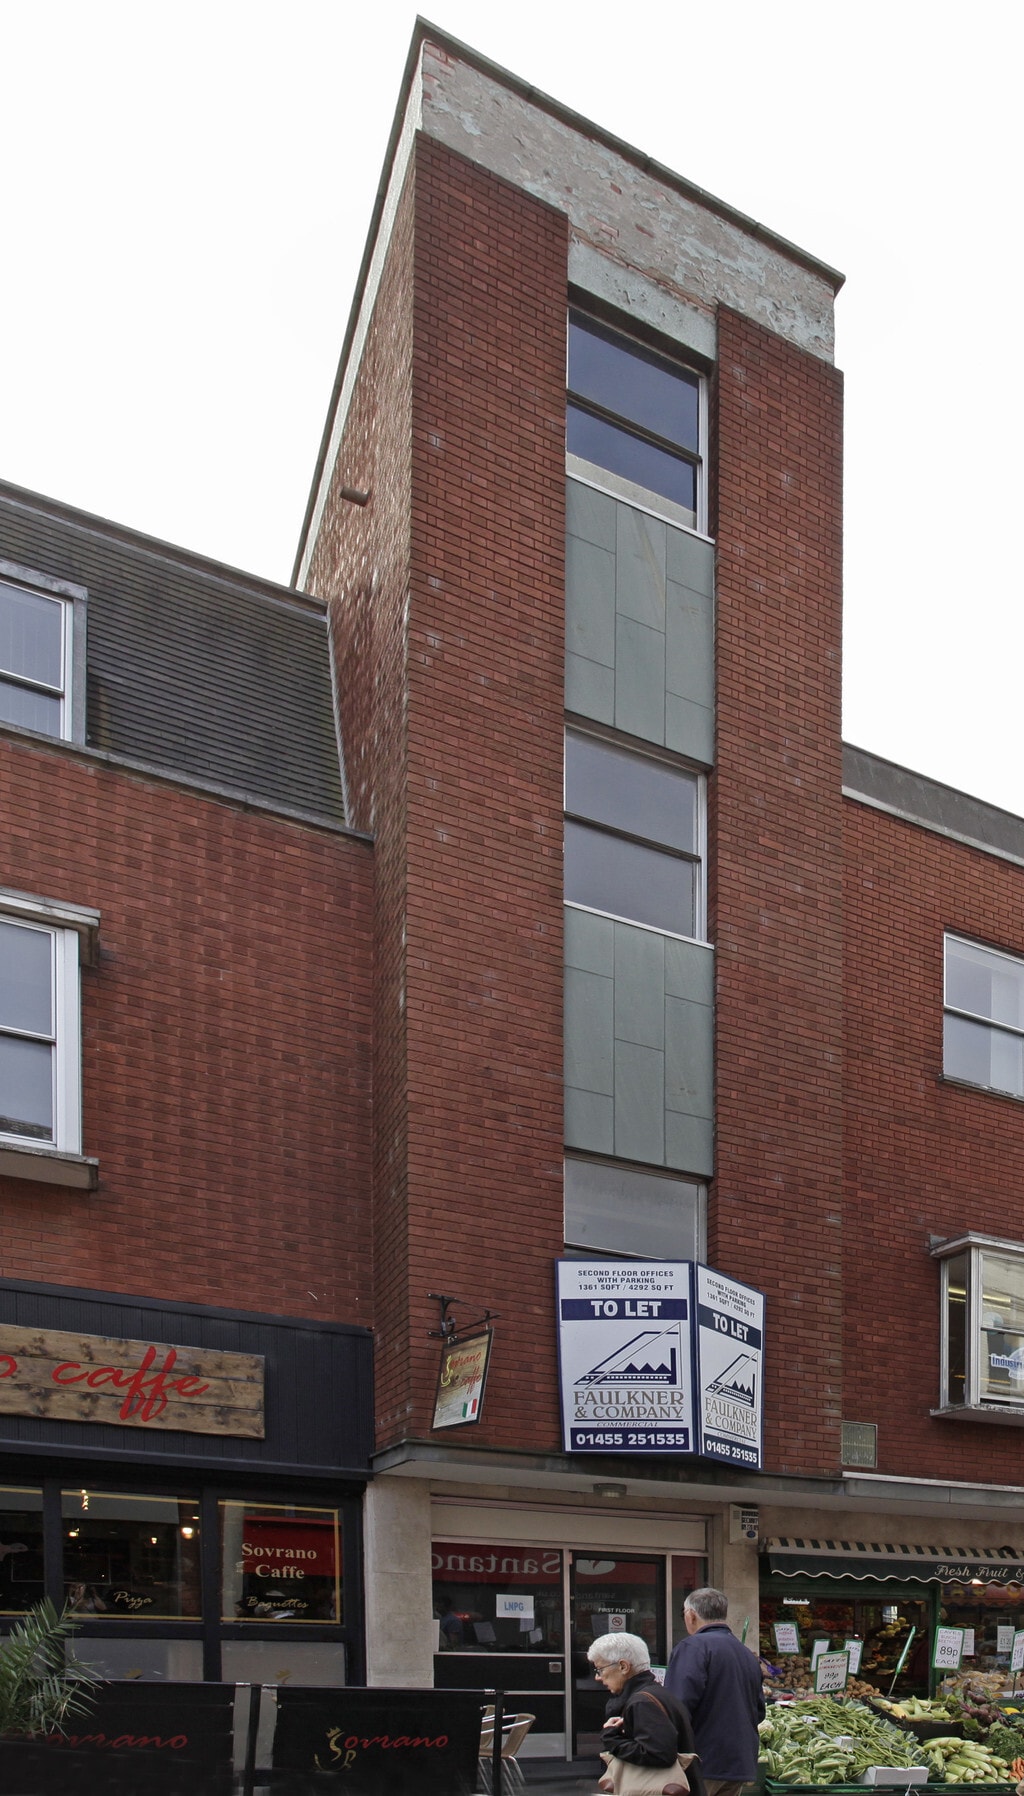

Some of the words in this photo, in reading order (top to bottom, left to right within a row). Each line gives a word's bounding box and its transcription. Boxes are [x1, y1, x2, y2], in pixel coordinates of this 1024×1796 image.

[707, 1278, 724, 1291] SECOND
[725, 1286, 739, 1298] FLOOR
[739, 1293, 756, 1306] OFFICES
[717, 1290, 729, 1300] WITH
[729, 1295, 747, 1308] PARKING
[590, 1300, 619, 1317] TO
[625, 1301, 662, 1317] LET
[712, 1312, 729, 1332] TO
[731, 1320, 749, 1342] LET
[52, 1345, 210, 1423] caffe
[573, 1391, 685, 1405] FAULKNER
[574, 1406, 588, 1419] &
[592, 1406, 684, 1419] COMPANY
[705, 1397, 758, 1427] FAULKNER
[705, 1413, 713, 1425] &
[715, 1416, 757, 1439] COMPANY
[576, 1433, 623, 1445] 01455
[628, 1434, 685, 1445] 251535
[706, 1440, 731, 1456] 01455
[731, 1447, 758, 1463] 251535
[241, 1543, 318, 1560] Sovrano
[255, 1564, 305, 1579] Caffe
[934, 1564, 970, 1577] Fresh
[975, 1565, 1008, 1578] Fruit
[1015, 1568, 1024, 1579] &
[113, 1590, 153, 1609] Pizza
[246, 1596, 309, 1611] Baguettes
[504, 1602, 524, 1611] LNPG
[939, 1646, 959, 1657] 89p
[820, 1681, 842, 1690] EACH
